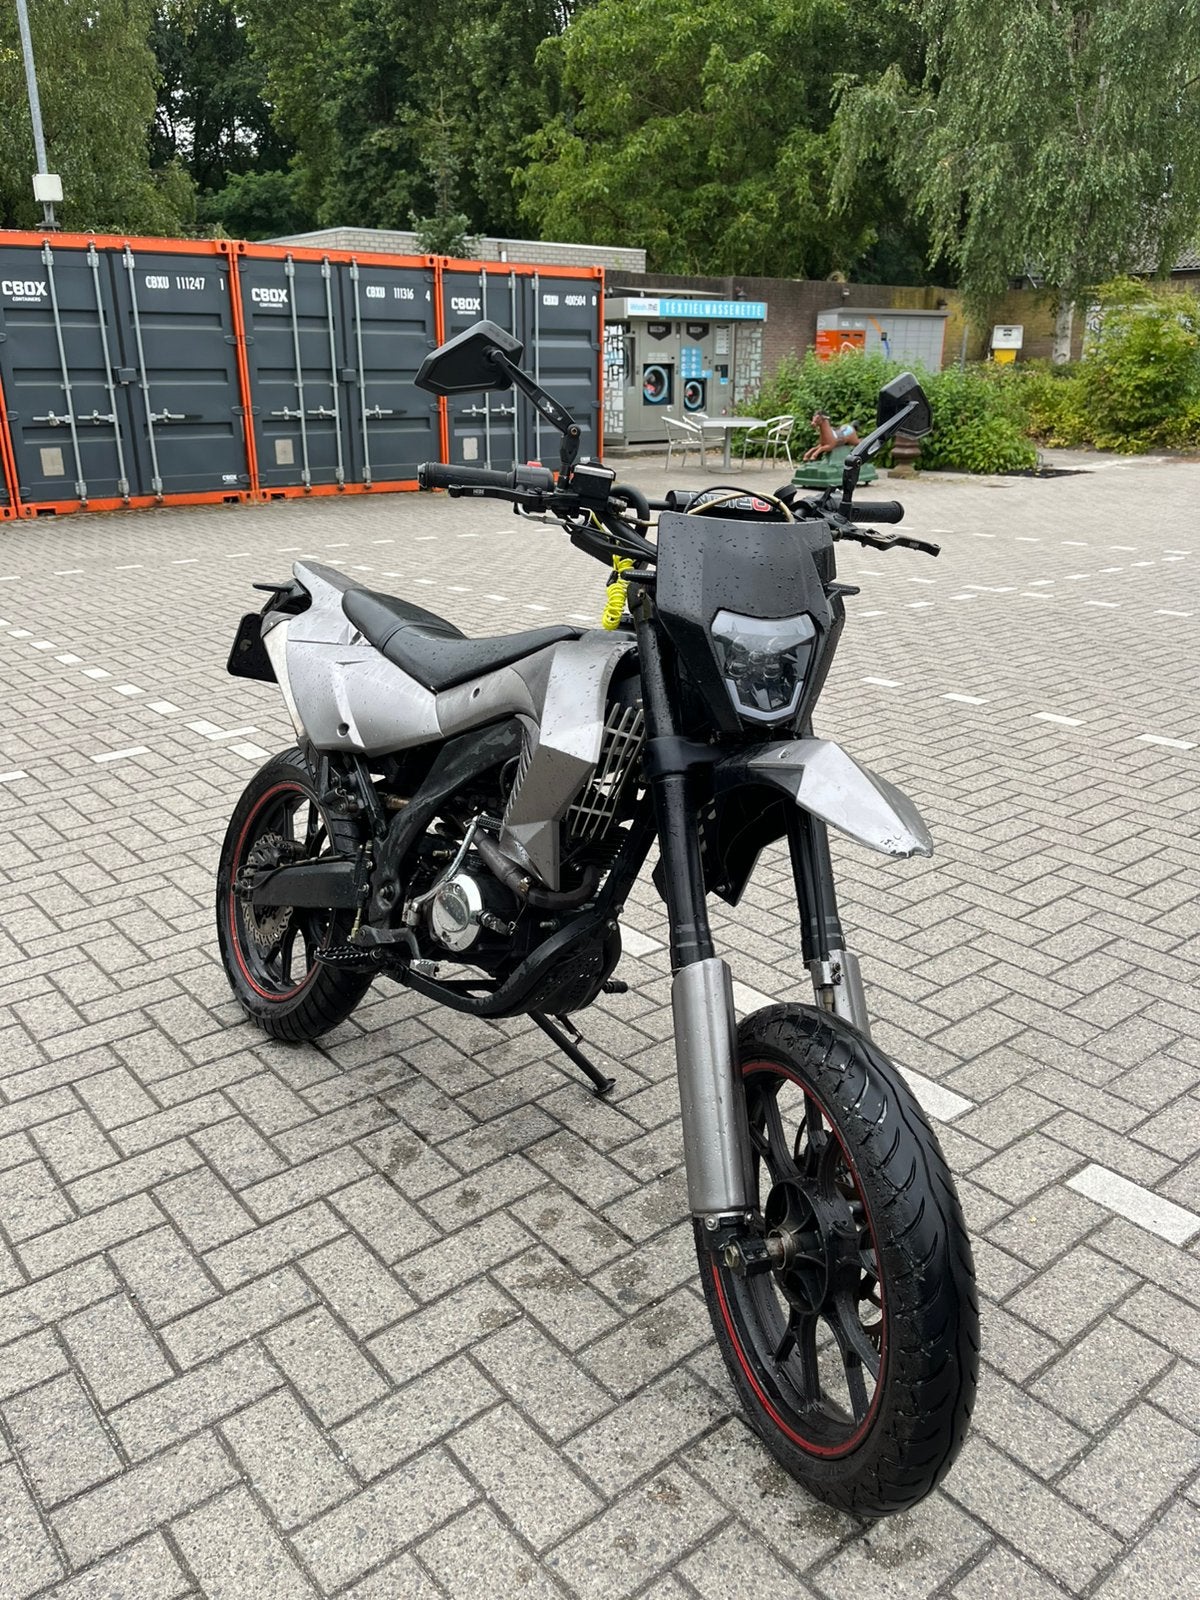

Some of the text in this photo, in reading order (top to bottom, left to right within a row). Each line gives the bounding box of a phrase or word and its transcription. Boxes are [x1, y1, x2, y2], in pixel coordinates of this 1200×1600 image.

[1, 280, 48, 296] CBOX
[145, 275, 225, 291] CBXU 111247 1
[251, 287, 288, 303] CBOX
[366, 286, 431, 302] CBXU 111316 4
[451, 297, 481, 310] CBOX
[665, 301, 761, 316] TEXTIELWASSERETTE
